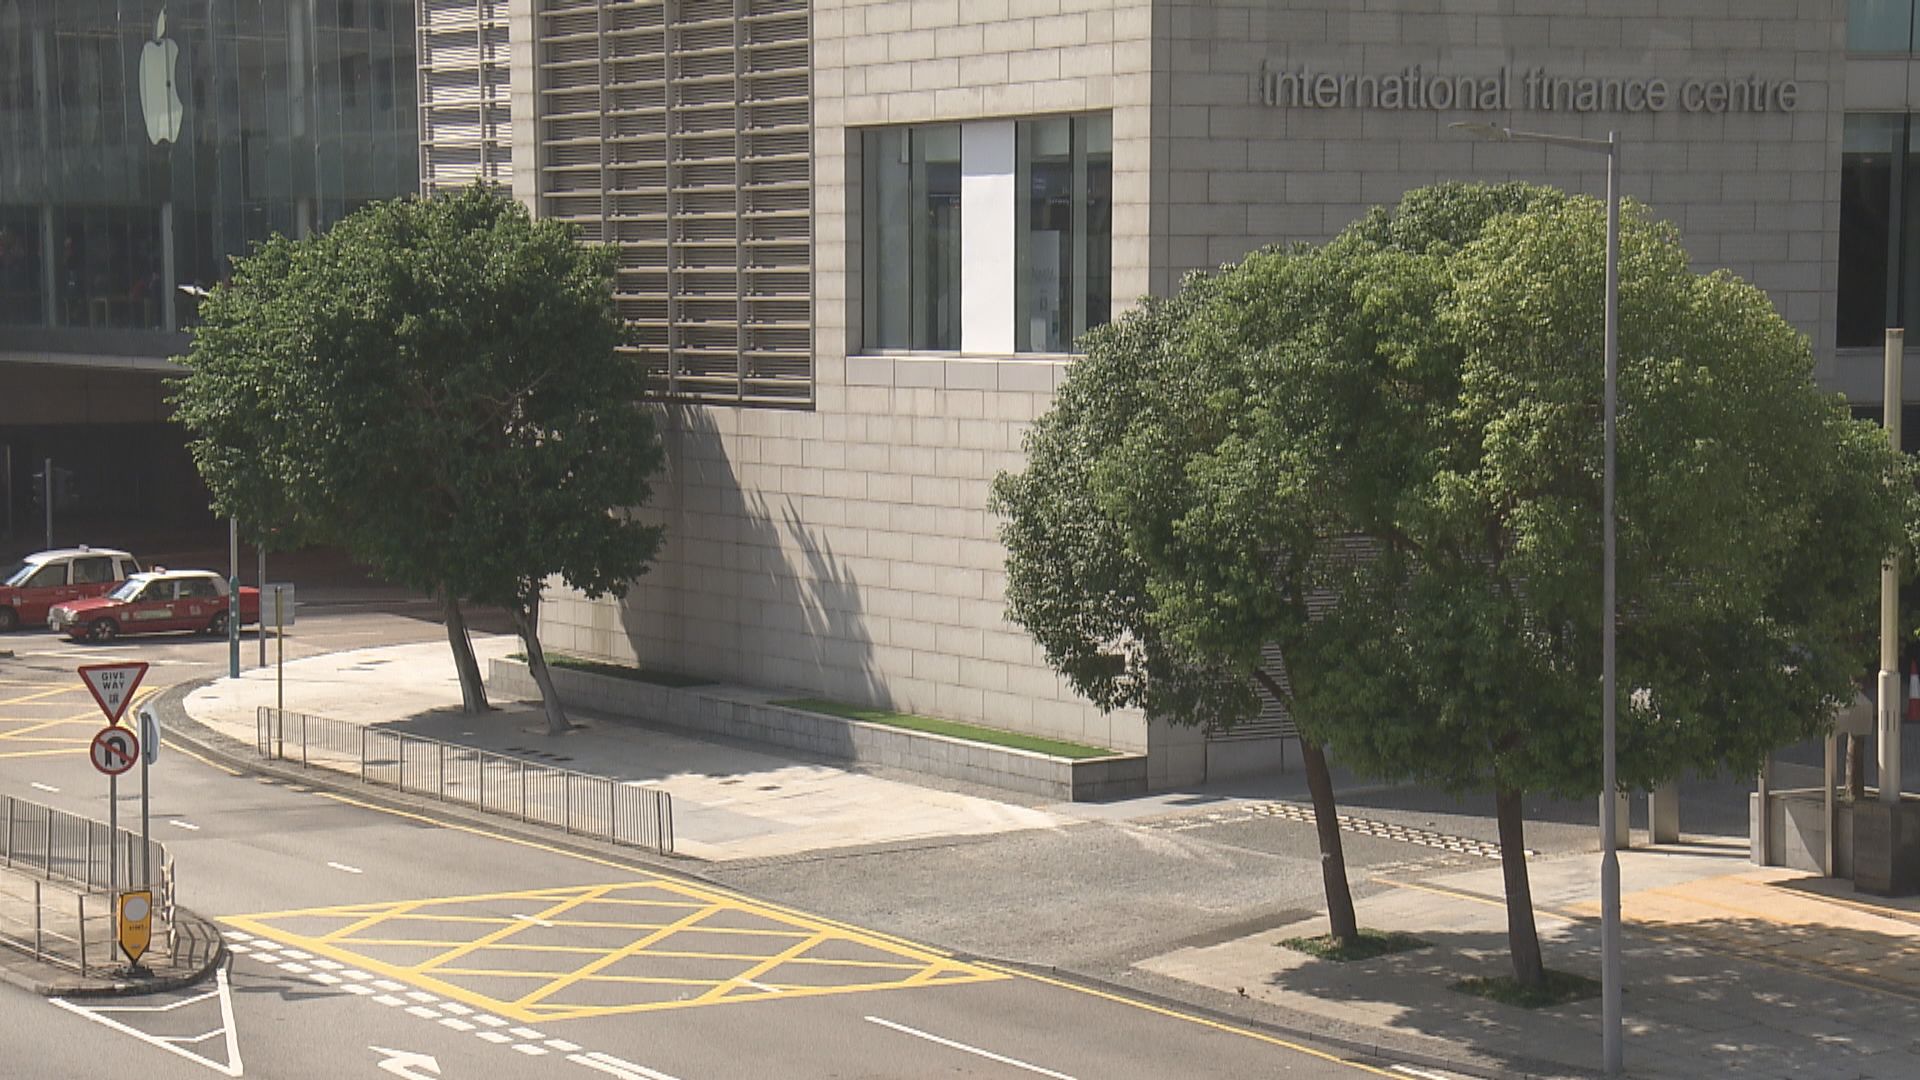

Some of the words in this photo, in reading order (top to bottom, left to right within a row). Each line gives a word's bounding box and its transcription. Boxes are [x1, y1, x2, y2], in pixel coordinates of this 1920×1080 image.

[1262, 60, 1512, 110] international
[1526, 67, 1670, 112] finance
[1682, 73, 1798, 112] centre
[101, 671, 125, 681] GIVE
[102, 681, 125, 690] WAY
